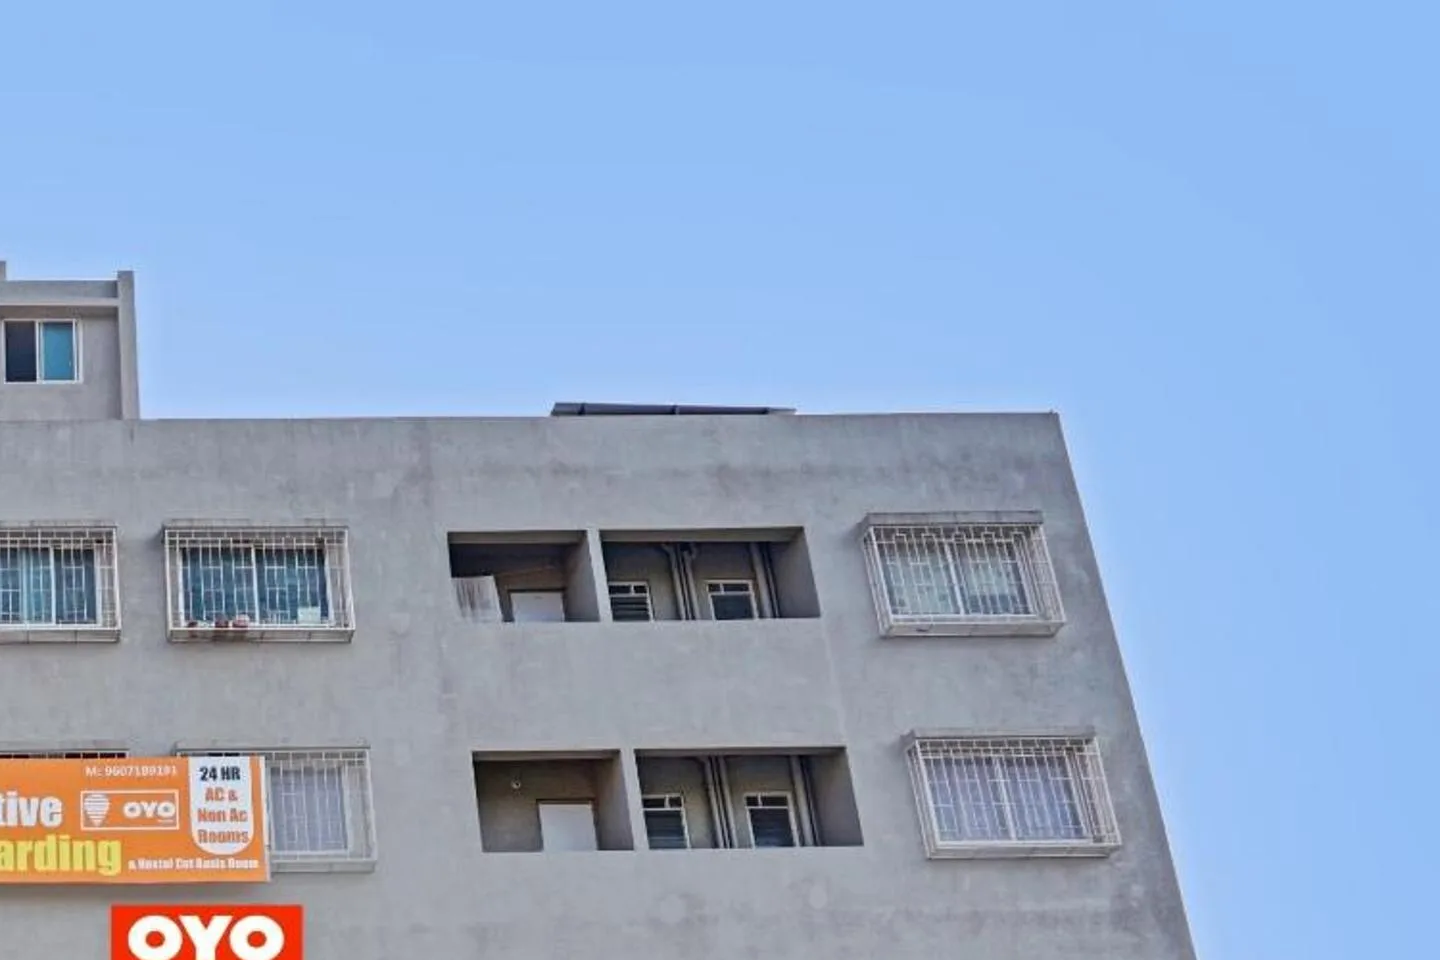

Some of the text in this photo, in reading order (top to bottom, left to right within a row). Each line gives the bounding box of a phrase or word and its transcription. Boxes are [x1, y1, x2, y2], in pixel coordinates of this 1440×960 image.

[199, 767, 241, 781] 24 HR
[204, 787, 224, 801] AC
[122, 801, 176, 820] OYO
[197, 809, 224, 823] Non
[197, 829, 249, 843] Rooms
